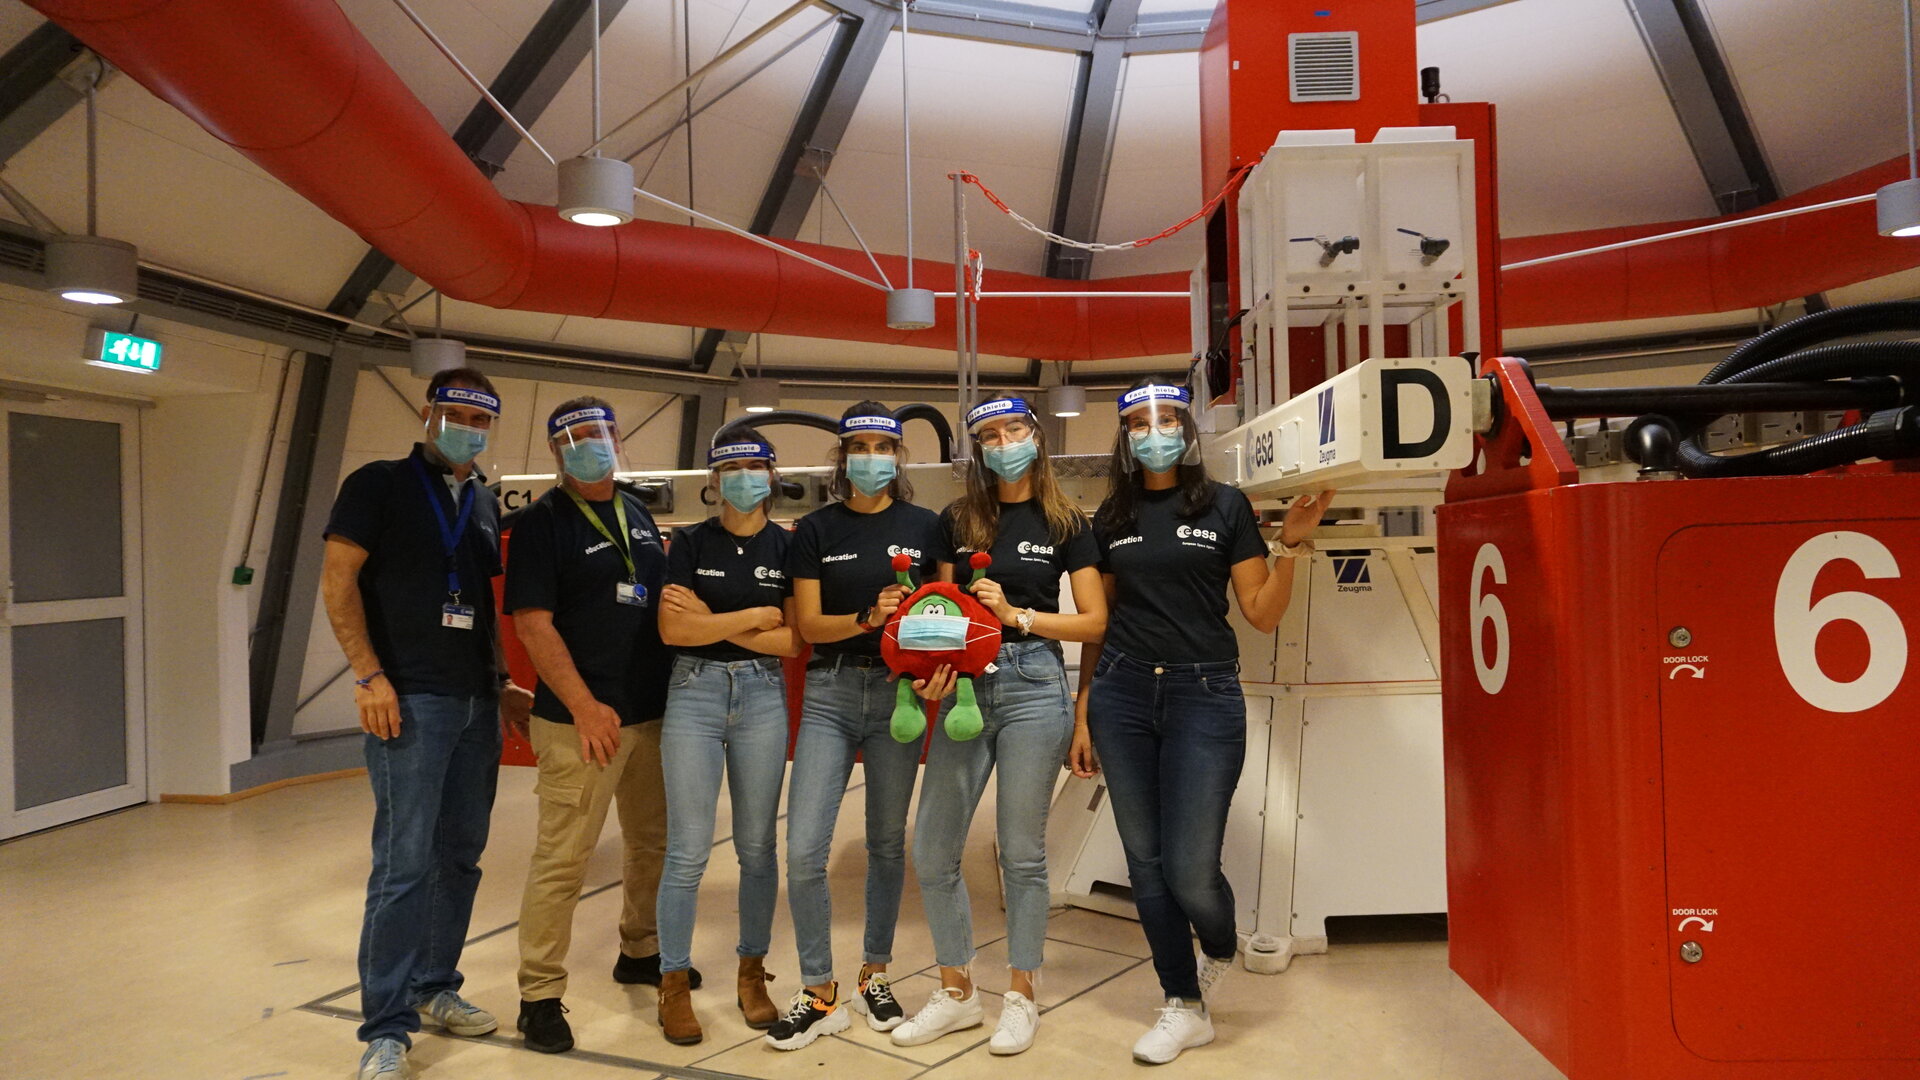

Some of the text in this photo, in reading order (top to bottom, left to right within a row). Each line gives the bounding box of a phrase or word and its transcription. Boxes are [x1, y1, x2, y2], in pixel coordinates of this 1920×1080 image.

[473, 394, 495, 404] Shield
[1129, 390, 1147, 399] Face
[982, 402, 1007, 412] Shield
[559, 414, 576, 424] Face
[1380, 368, 1452, 460] D
[869, 418, 893, 426] Shield
[713, 448, 729, 456] Face
[1255, 430, 1274, 468] esa
[1319, 449, 1336, 465] Zeugma
[503, 489, 532, 511] C1
[1108, 535, 1143, 550] education
[821, 552, 858, 564] education
[695, 567, 725, 577] ucation
[1337, 584, 1373, 594] Zeugma
[1469, 542, 1510, 695] 6
[1773, 530, 1908, 713] 6
[1663, 655, 1709, 664] DOOR LOCK
[1672, 908, 1719, 916] DOOR LOCK
